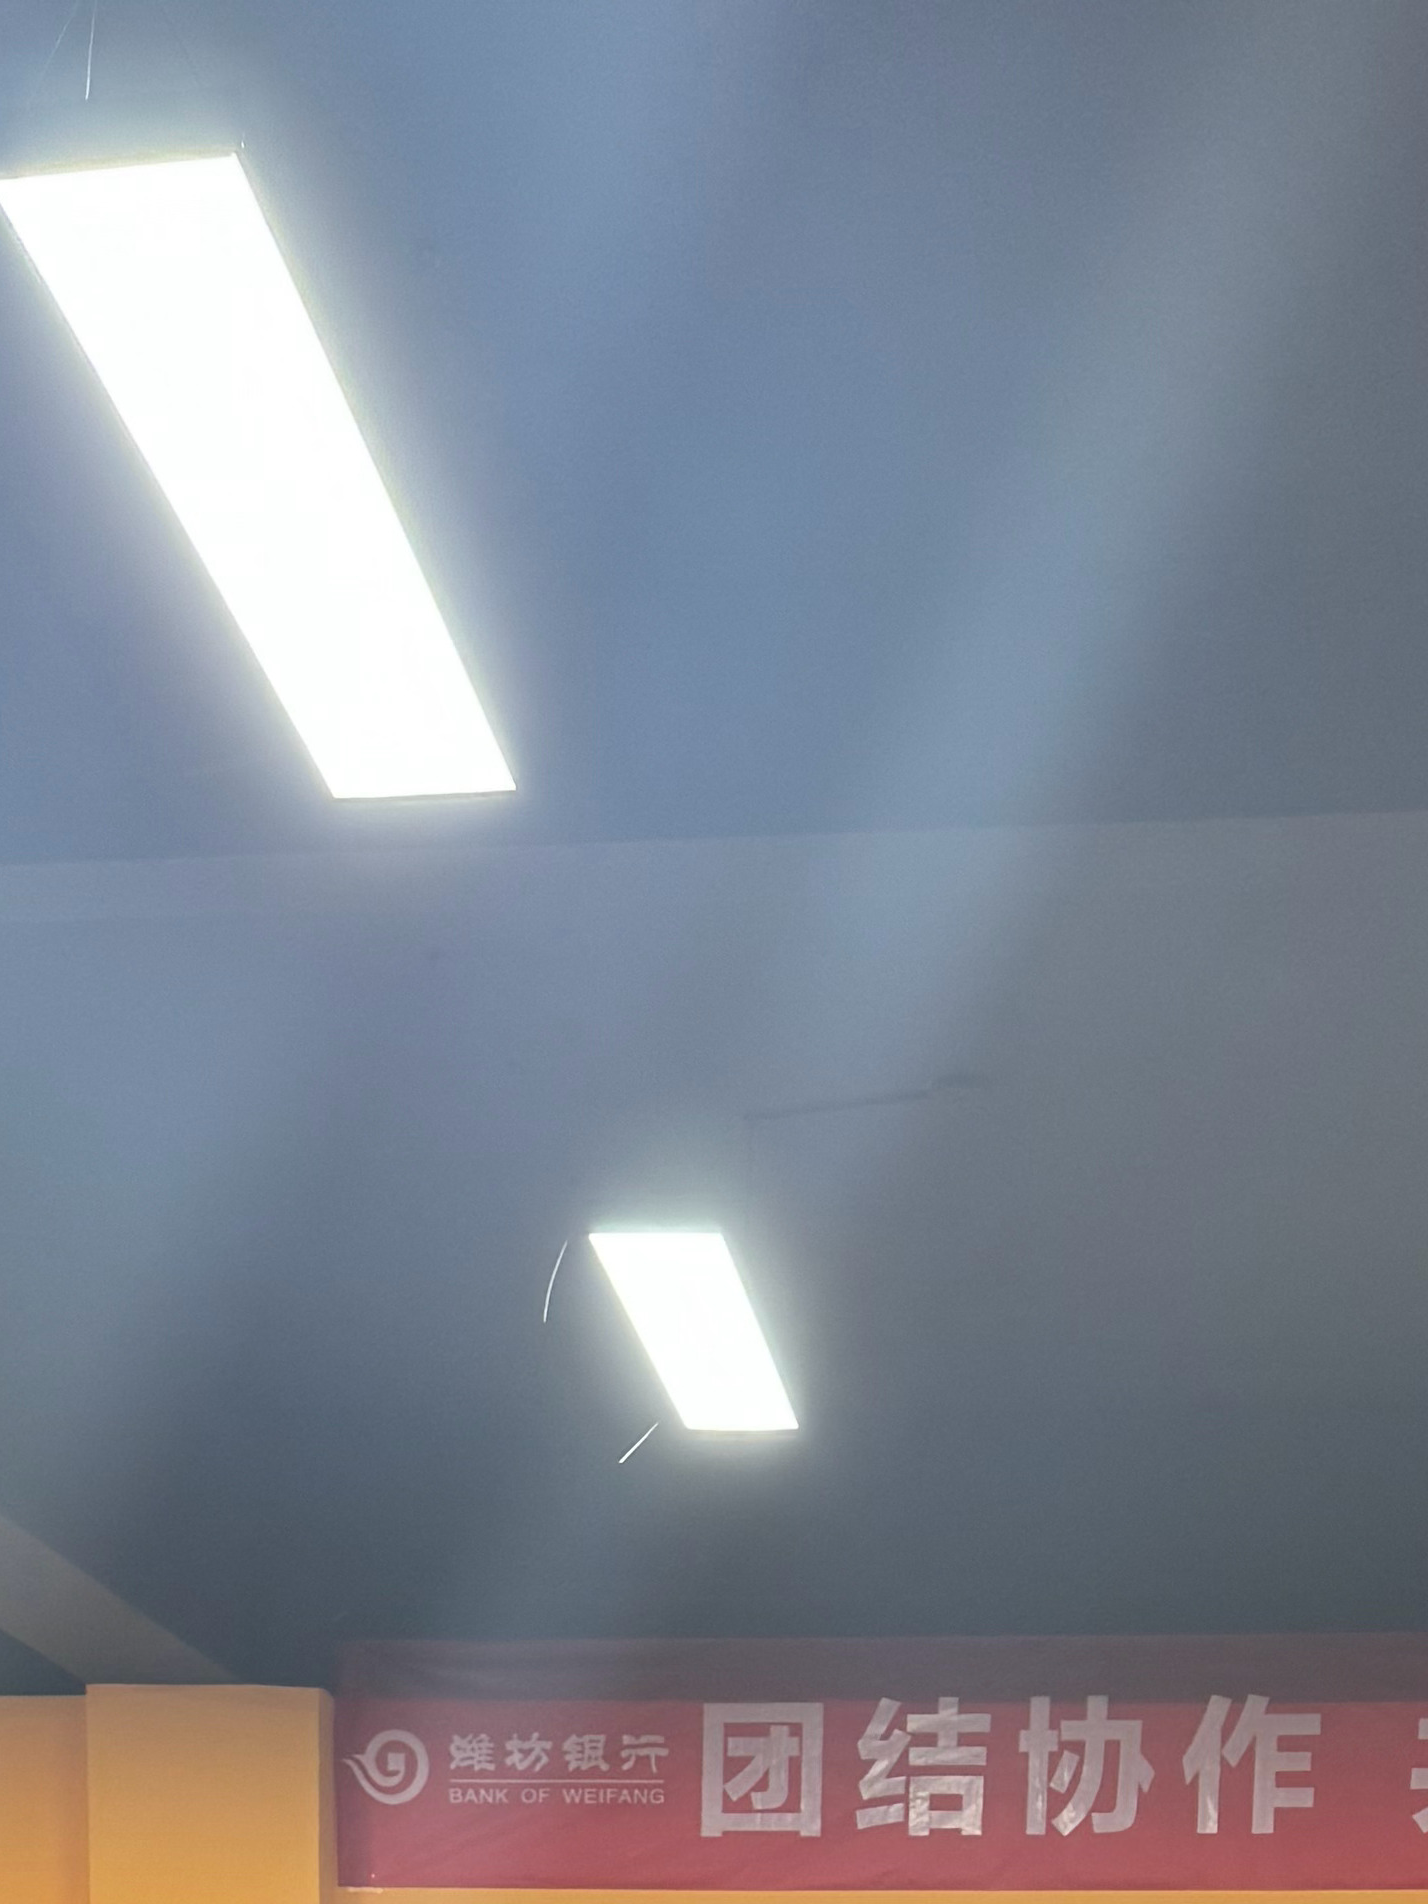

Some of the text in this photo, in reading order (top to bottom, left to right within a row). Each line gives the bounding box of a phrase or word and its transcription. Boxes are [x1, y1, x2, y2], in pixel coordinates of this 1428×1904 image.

[449, 1732, 669, 1773] 潍坊银行
[700, 1694, 1321, 1837] 团结协作
[449, 1788, 665, 1804] BANK OF WEIFANG
